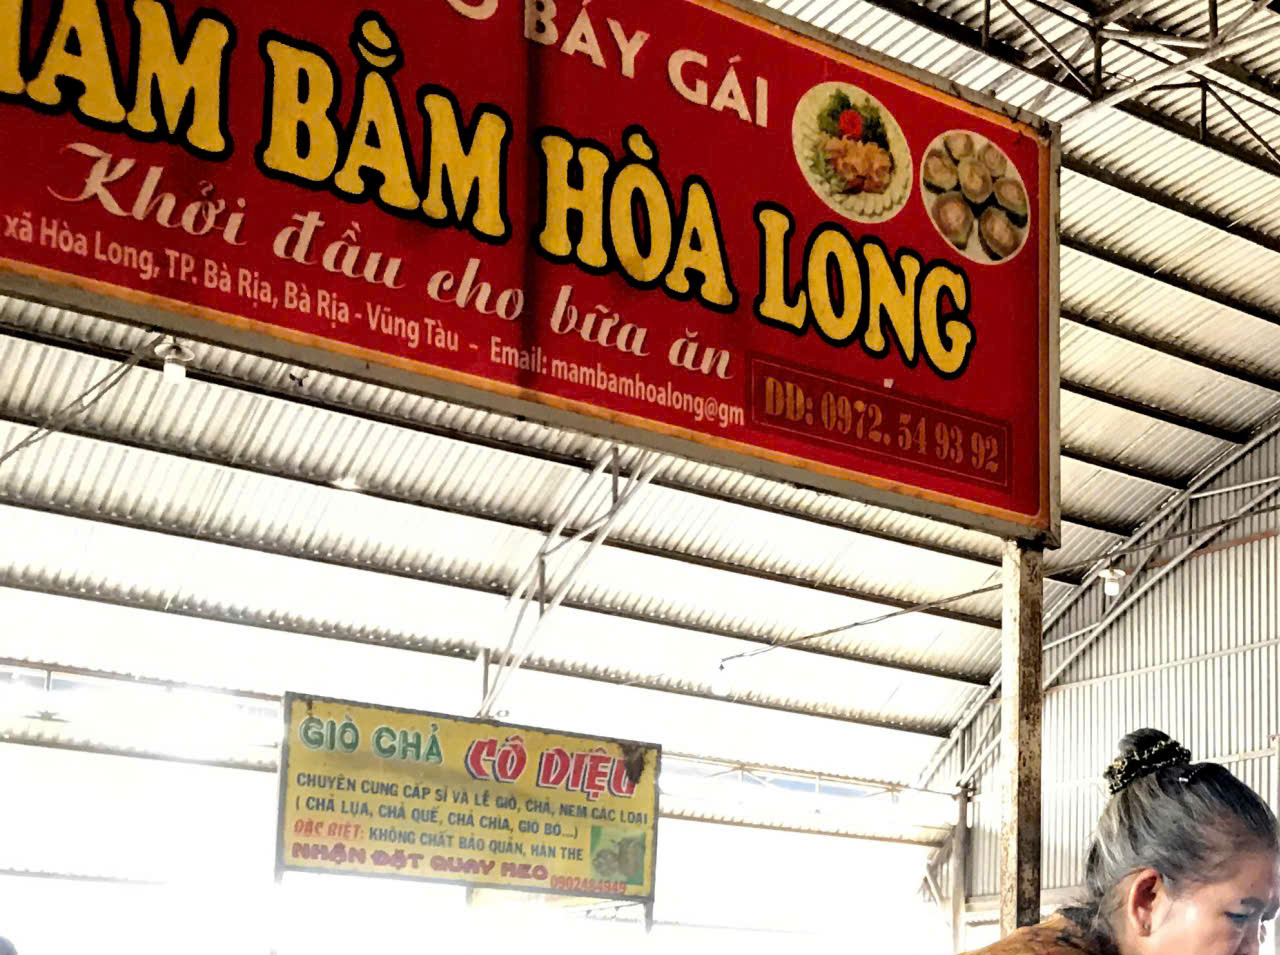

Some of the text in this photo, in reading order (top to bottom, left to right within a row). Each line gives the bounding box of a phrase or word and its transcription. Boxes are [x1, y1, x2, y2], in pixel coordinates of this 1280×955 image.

[667, 54, 768, 128] GÁI
[257, 14, 510, 241] BẰM
[536, 128, 736, 309] HÒA
[755, 206, 974, 376] LONG
[47, 142, 735, 380] Khởi đầu cho bữa ăn
[4, 211, 33, 243] xã
[40, 216, 88, 257] Hòa
[94, 231, 160, 280] Long,
[165, 248, 198, 285] TP.
[204, 259, 232, 294] Bà
[238, 267, 279, 309] Rịa,
[285, 280, 311, 314] Bà
[317, 289, 349, 329] Rịa
[366, 301, 420, 349] Vũng
[424, 317, 459, 351] Tàu
[490, 335, 548, 375] Email:
[551, 357, 745, 428] mambamhoalong@gm
[820, 391, 891, 446] 0972.
[898, 413, 928, 456] 54
[935, 422, 964, 465] 93
[971, 431, 999, 474] 92
[296, 772, 357, 793] CHUYÊN
[361, 780, 399, 798] CUNG
[299, 714, 361, 754] GIÒ
[372, 722, 445, 766] CHẢ
[465, 735, 528, 783] CÔ
